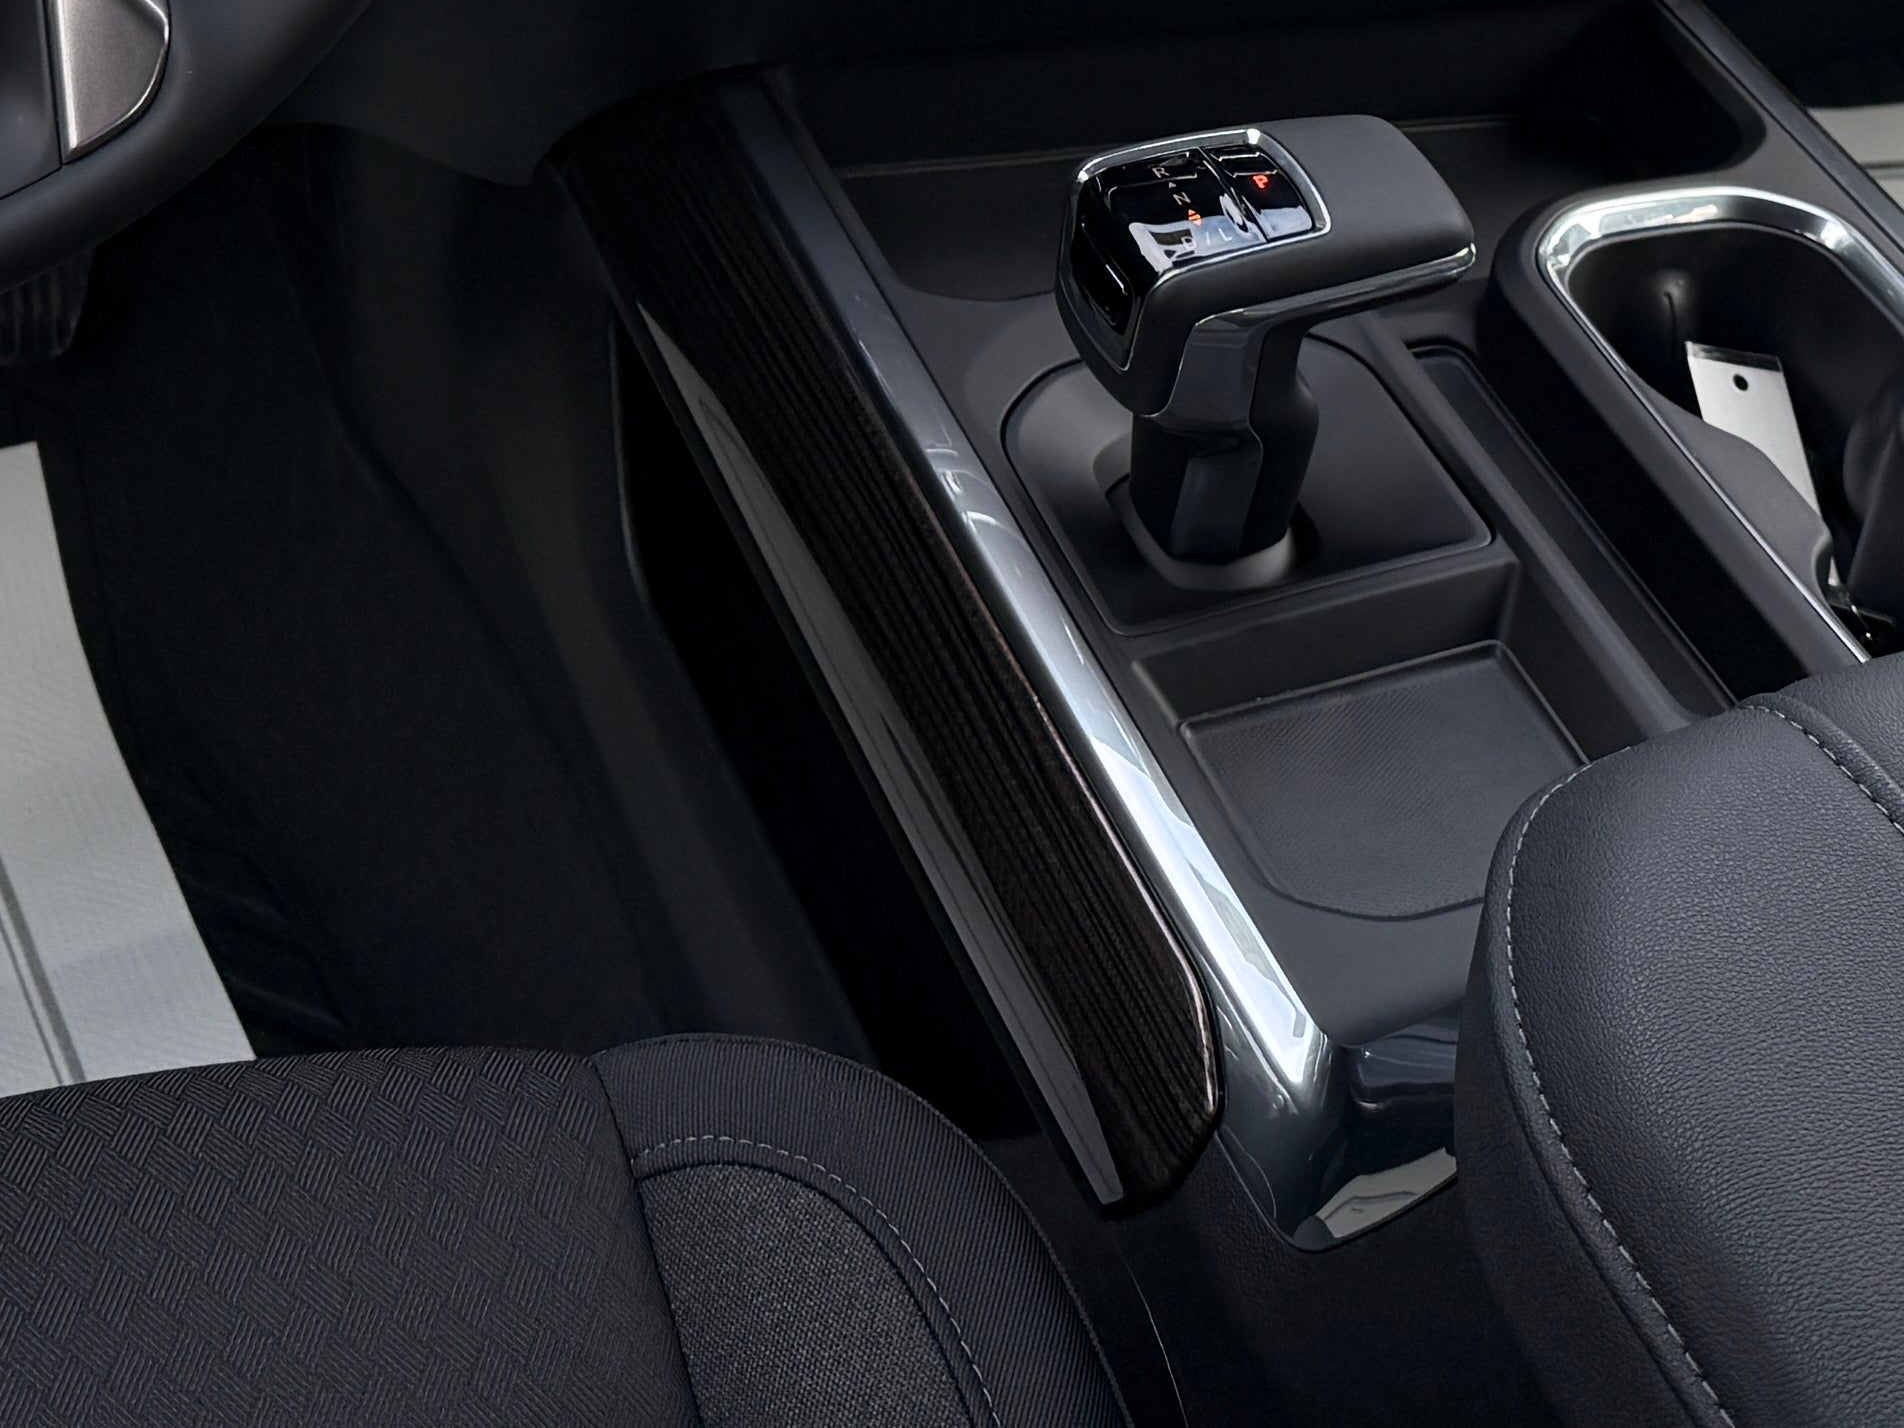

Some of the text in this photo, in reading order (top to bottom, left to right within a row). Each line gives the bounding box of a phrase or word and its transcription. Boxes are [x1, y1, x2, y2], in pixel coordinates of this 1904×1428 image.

[1152, 167, 1170, 179] R
[1252, 174, 1269, 189] P
[1173, 192, 1191, 205] N
